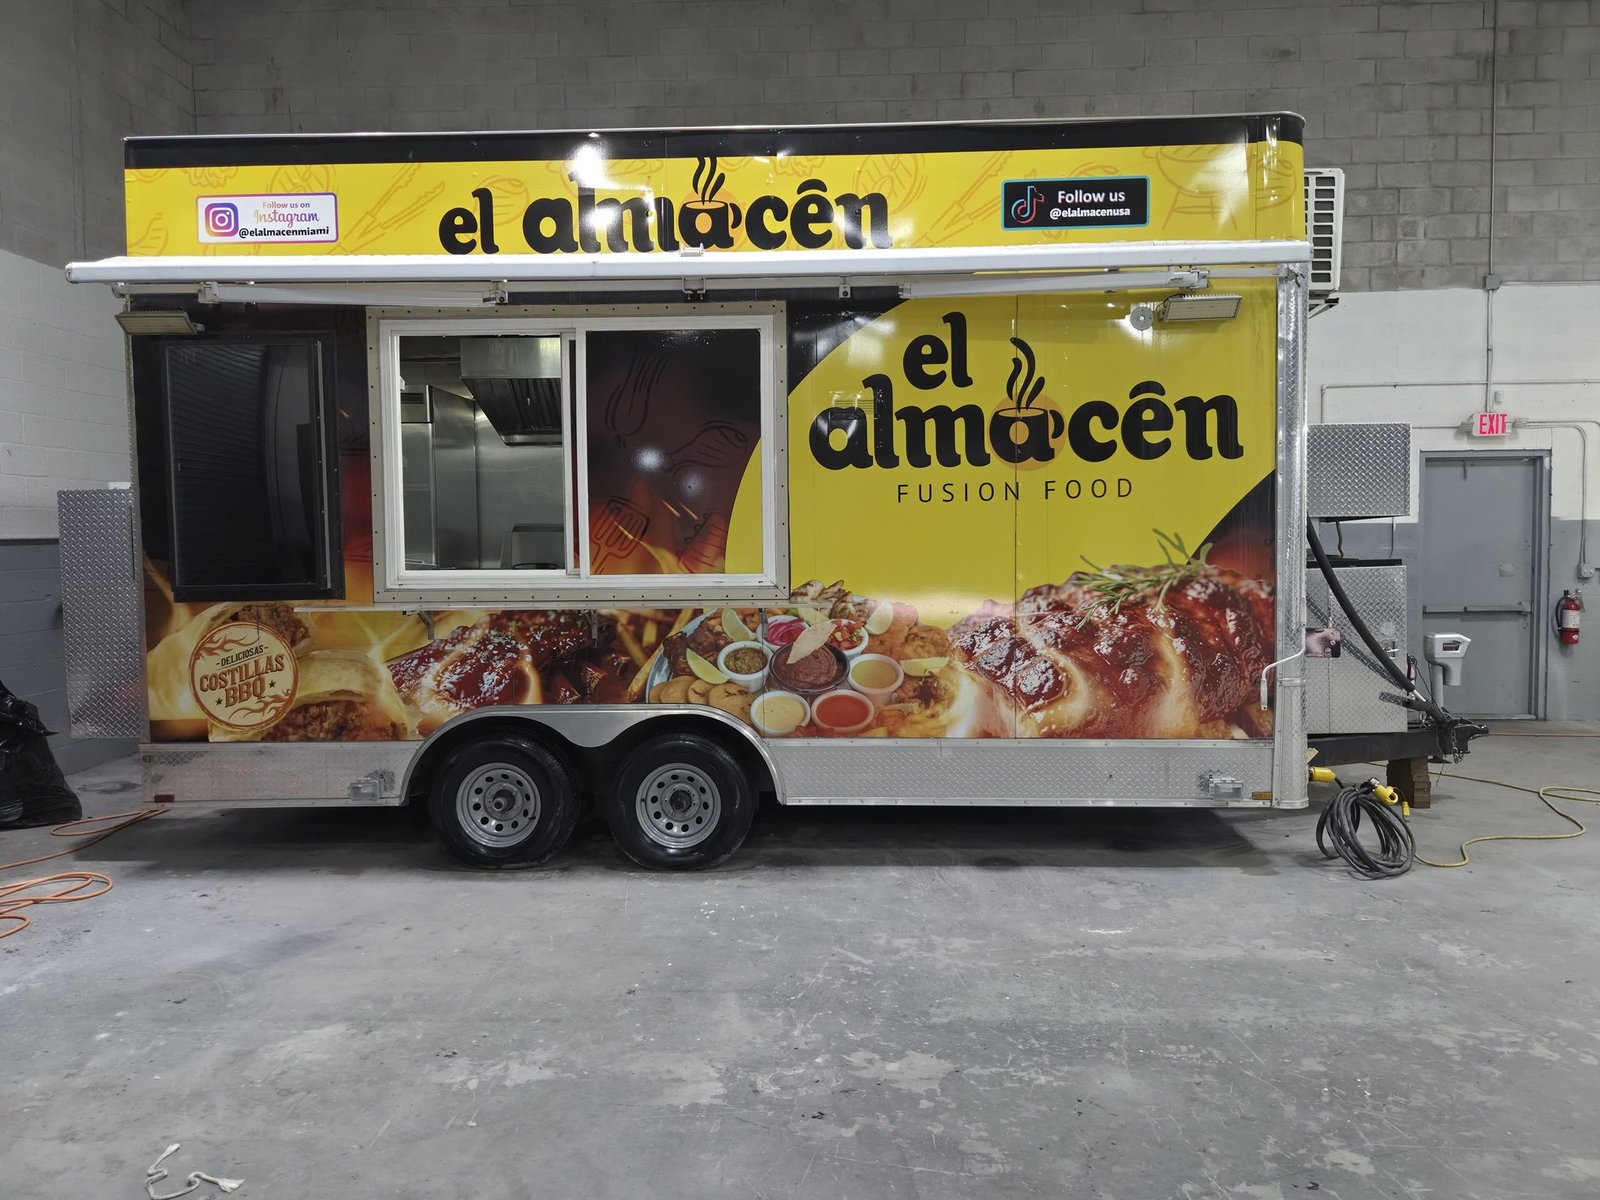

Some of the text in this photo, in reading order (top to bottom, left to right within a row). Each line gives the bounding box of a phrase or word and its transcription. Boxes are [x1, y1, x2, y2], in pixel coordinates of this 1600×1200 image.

[1057, 190, 1126, 204] Follow us
[254, 209, 320, 227] Instagram
[438, 188, 499, 255] el
[1049, 207, 1131, 220] @elalmacenusa
[238, 226, 330, 239] @elalmacenmiami
[903, 312, 973, 390] el
[1479, 413, 1508, 435] EXIT
[897, 478, 1133, 503] FUSION FOOD
[199, 654, 285, 692] COSTILLAS
[224, 675, 266, 709] BBQ
